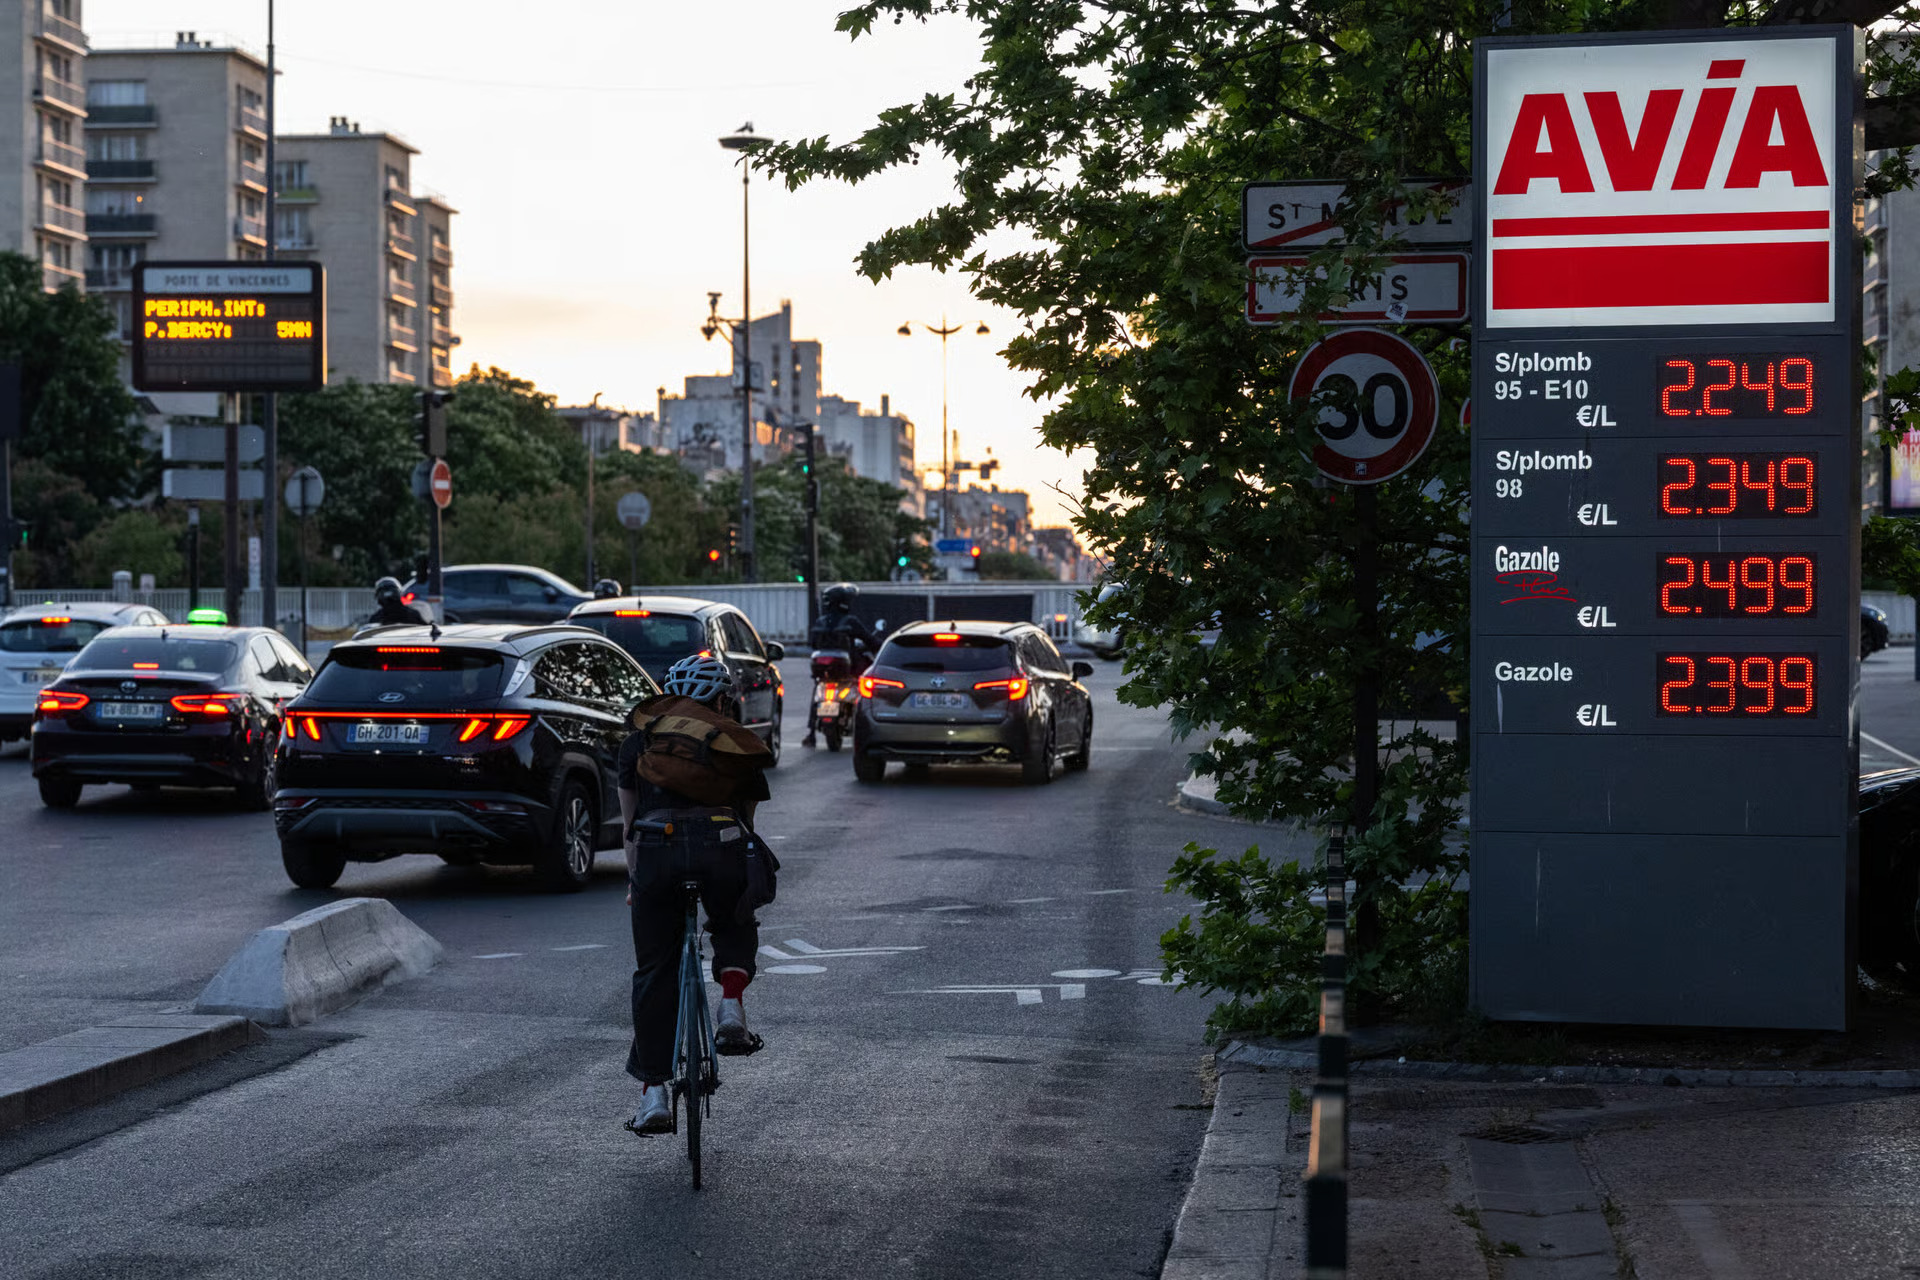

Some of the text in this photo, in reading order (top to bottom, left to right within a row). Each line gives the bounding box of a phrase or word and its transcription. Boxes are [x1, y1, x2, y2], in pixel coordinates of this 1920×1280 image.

[165, 275, 290, 287] PORTE DE VINCENNES
[1495, 352, 1592, 377] S/plomb
[1494, 380, 1522, 400] 95
[1545, 379, 1589, 399] E10
[1662, 358, 1813, 416] 2.249
[1316, 372, 1409, 440] 30
[1576, 405, 1617, 427] €/L
[1496, 450, 1593, 475] S/plomb
[1495, 479, 1523, 498] 98
[1662, 458, 1814, 514] 2.349
[1577, 504, 1618, 526] €/L
[1495, 546, 1560, 572] Gazole
[1662, 557, 1813, 613] 2.499
[1577, 606, 1617, 628] €/L
[1495, 661, 1573, 682] Gazole
[1662, 656, 1813, 713] 2.399
[1576, 704, 1617, 727] €/L
[357, 725, 419, 740] GH-201-QA
